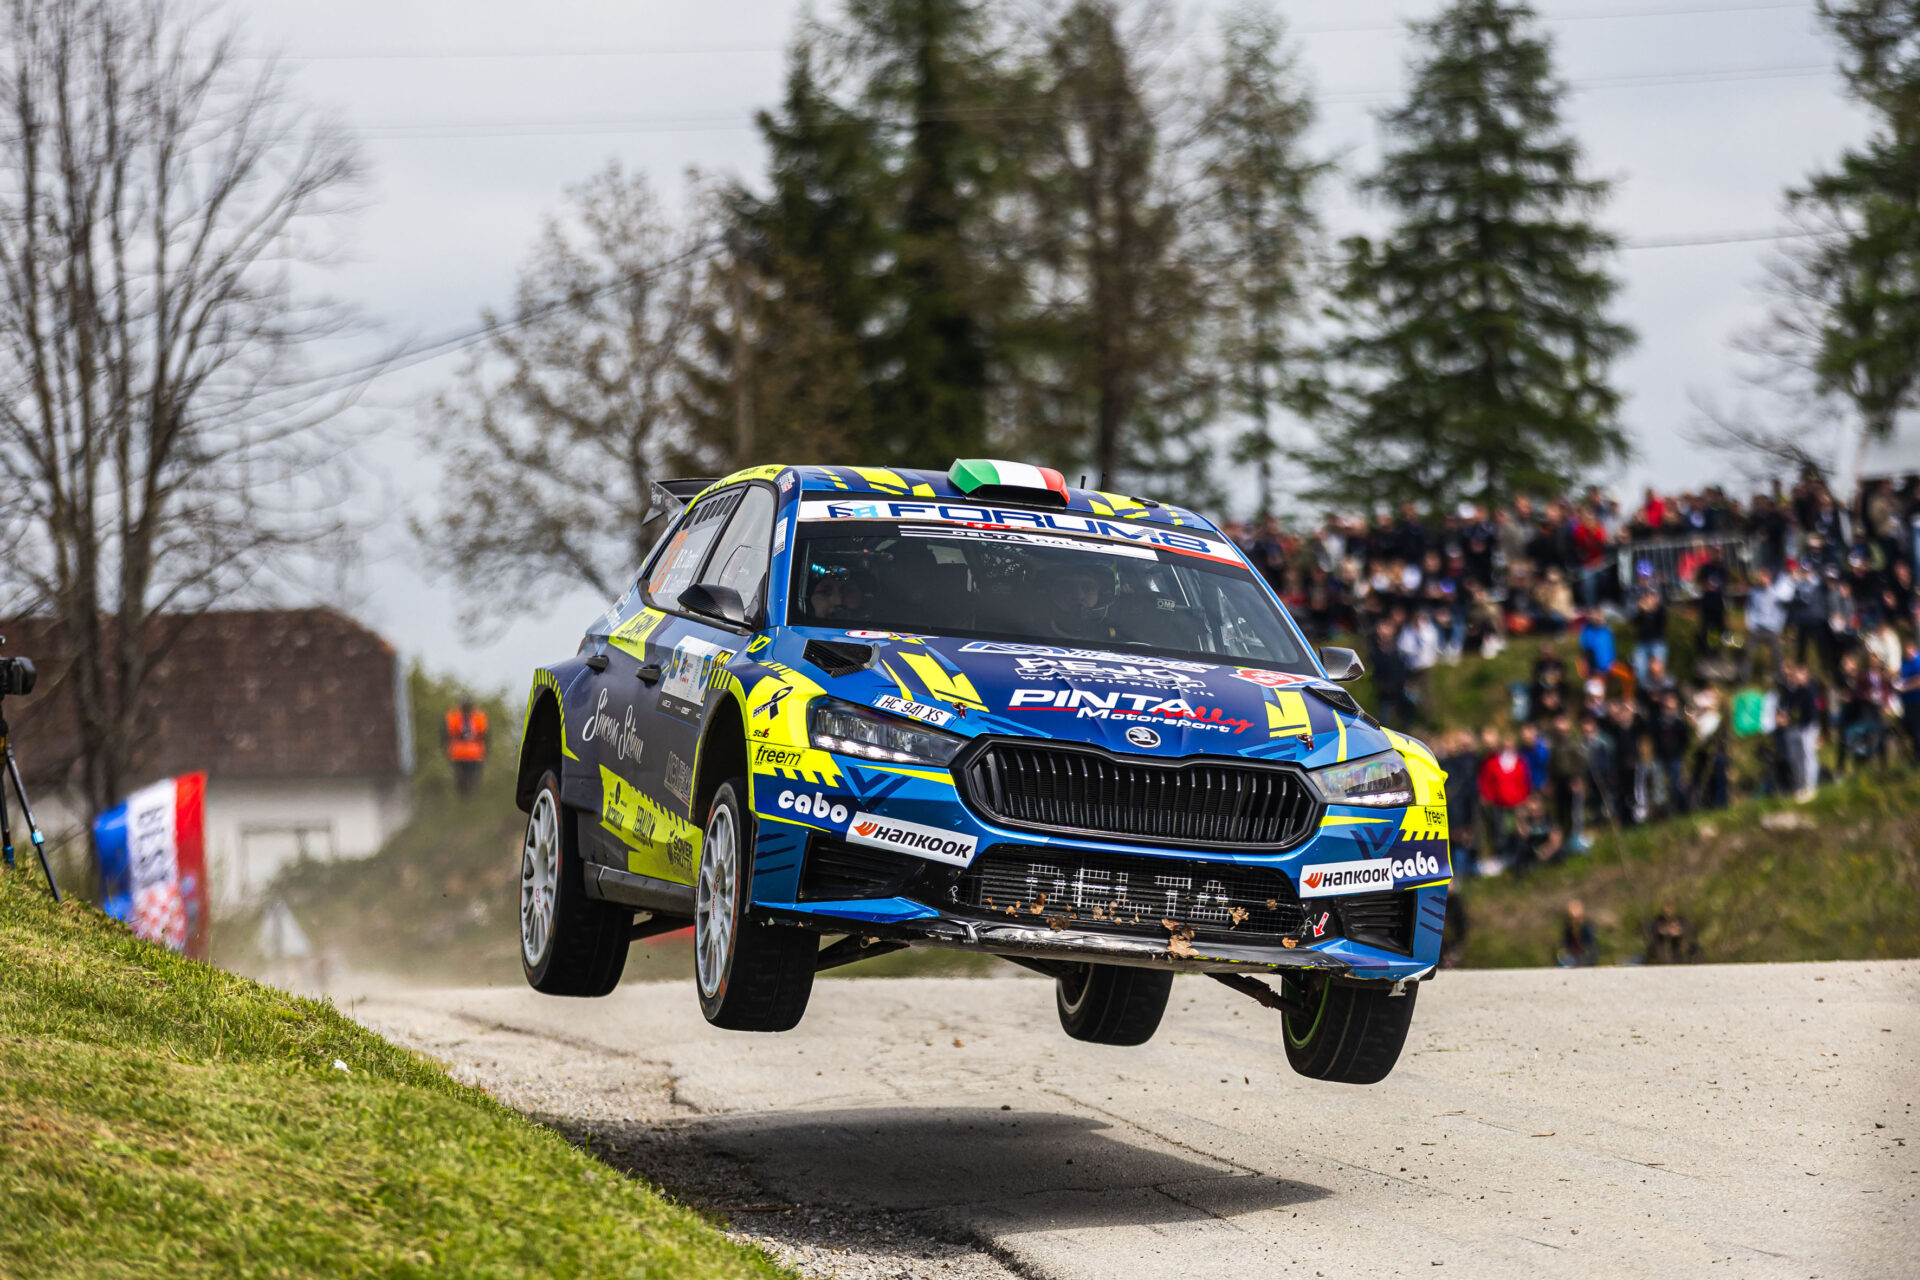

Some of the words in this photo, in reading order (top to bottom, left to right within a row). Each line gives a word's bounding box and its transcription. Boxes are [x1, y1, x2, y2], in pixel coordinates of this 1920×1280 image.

[888, 503, 1211, 553] FORUM8
[951, 530, 1023, 541] DELTA
[881, 696, 901, 710] HC
[901, 701, 924, 718] 941
[924, 708, 943, 722] XS
[1008, 688, 1197, 717] PINTA
[1076, 705, 1230, 733] Motorsport
[755, 745, 801, 766] freem
[778, 790, 848, 824] cabo
[1391, 851, 1439, 879] cabo
